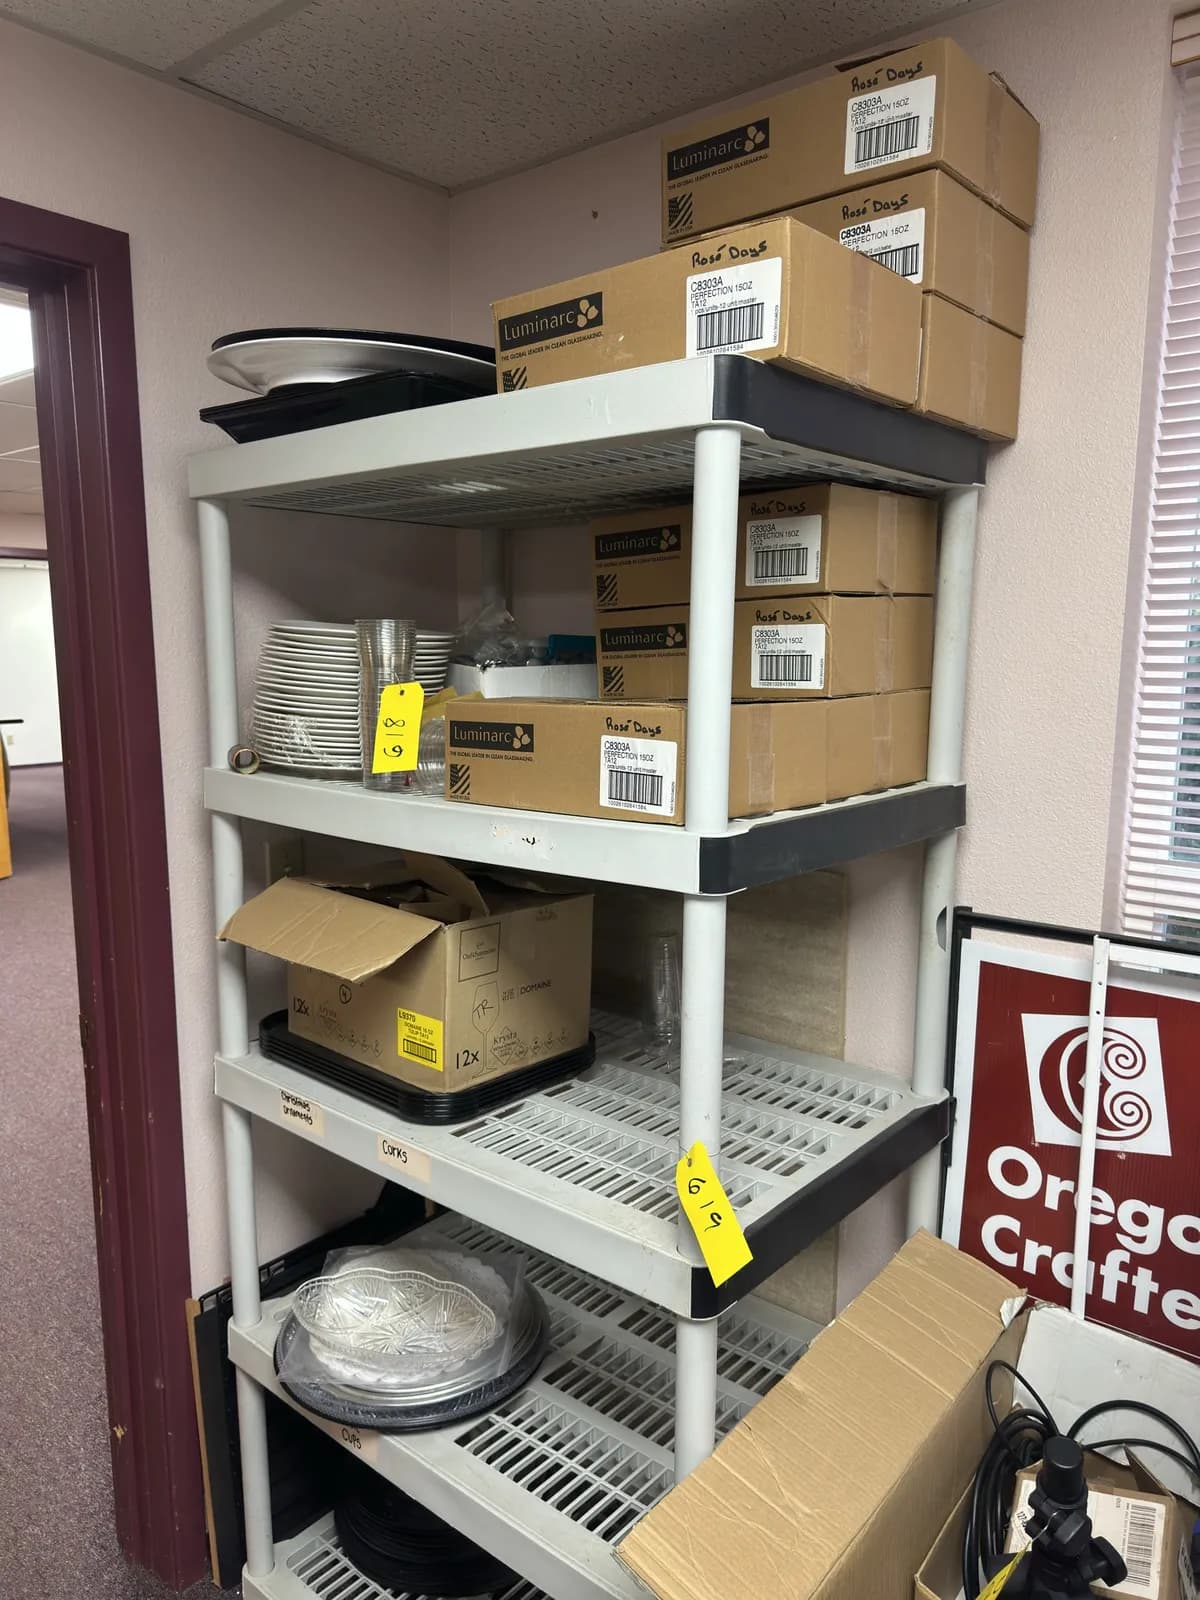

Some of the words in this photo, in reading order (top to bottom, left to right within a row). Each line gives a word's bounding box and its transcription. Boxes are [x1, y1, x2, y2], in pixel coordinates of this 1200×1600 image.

[851, 68, 883, 92] Rosé
[887, 61, 923, 81] Days
[851, 95, 882, 112] C8303A
[851, 102, 891, 119] PERFECTION
[673, 137, 742, 170] Luminarc
[842, 198, 871, 220] Rosé
[873, 193, 909, 212] Days
[841, 224, 872, 240] C8303A
[842, 231, 888, 246] PERFECTION
[692, 244, 726, 269] Rosé
[729, 240, 767, 259] Days
[690, 276, 724, 292] C8303A
[690, 285, 733, 301] PERFECTION
[735, 280, 753, 292] 15OZ
[691, 299, 707, 308] TA12
[504, 311, 576, 341] Luminarc
[750, 523, 776, 534] C8303A
[600, 535, 659, 553] Luminarc
[605, 630, 664, 646] Luminarc
[754, 629, 780, 638] C8303A
[454, 726, 512, 743] Luminarc
[606, 717, 632, 731] Rosé
[633, 721, 662, 737] Days
[383, 717, 406, 758] 618
[604, 740, 631, 752] C8303A
[603, 749, 638, 761] PERFECTION
[604, 756, 617, 764] TA12
[456, 1049, 480, 1070] 12x
